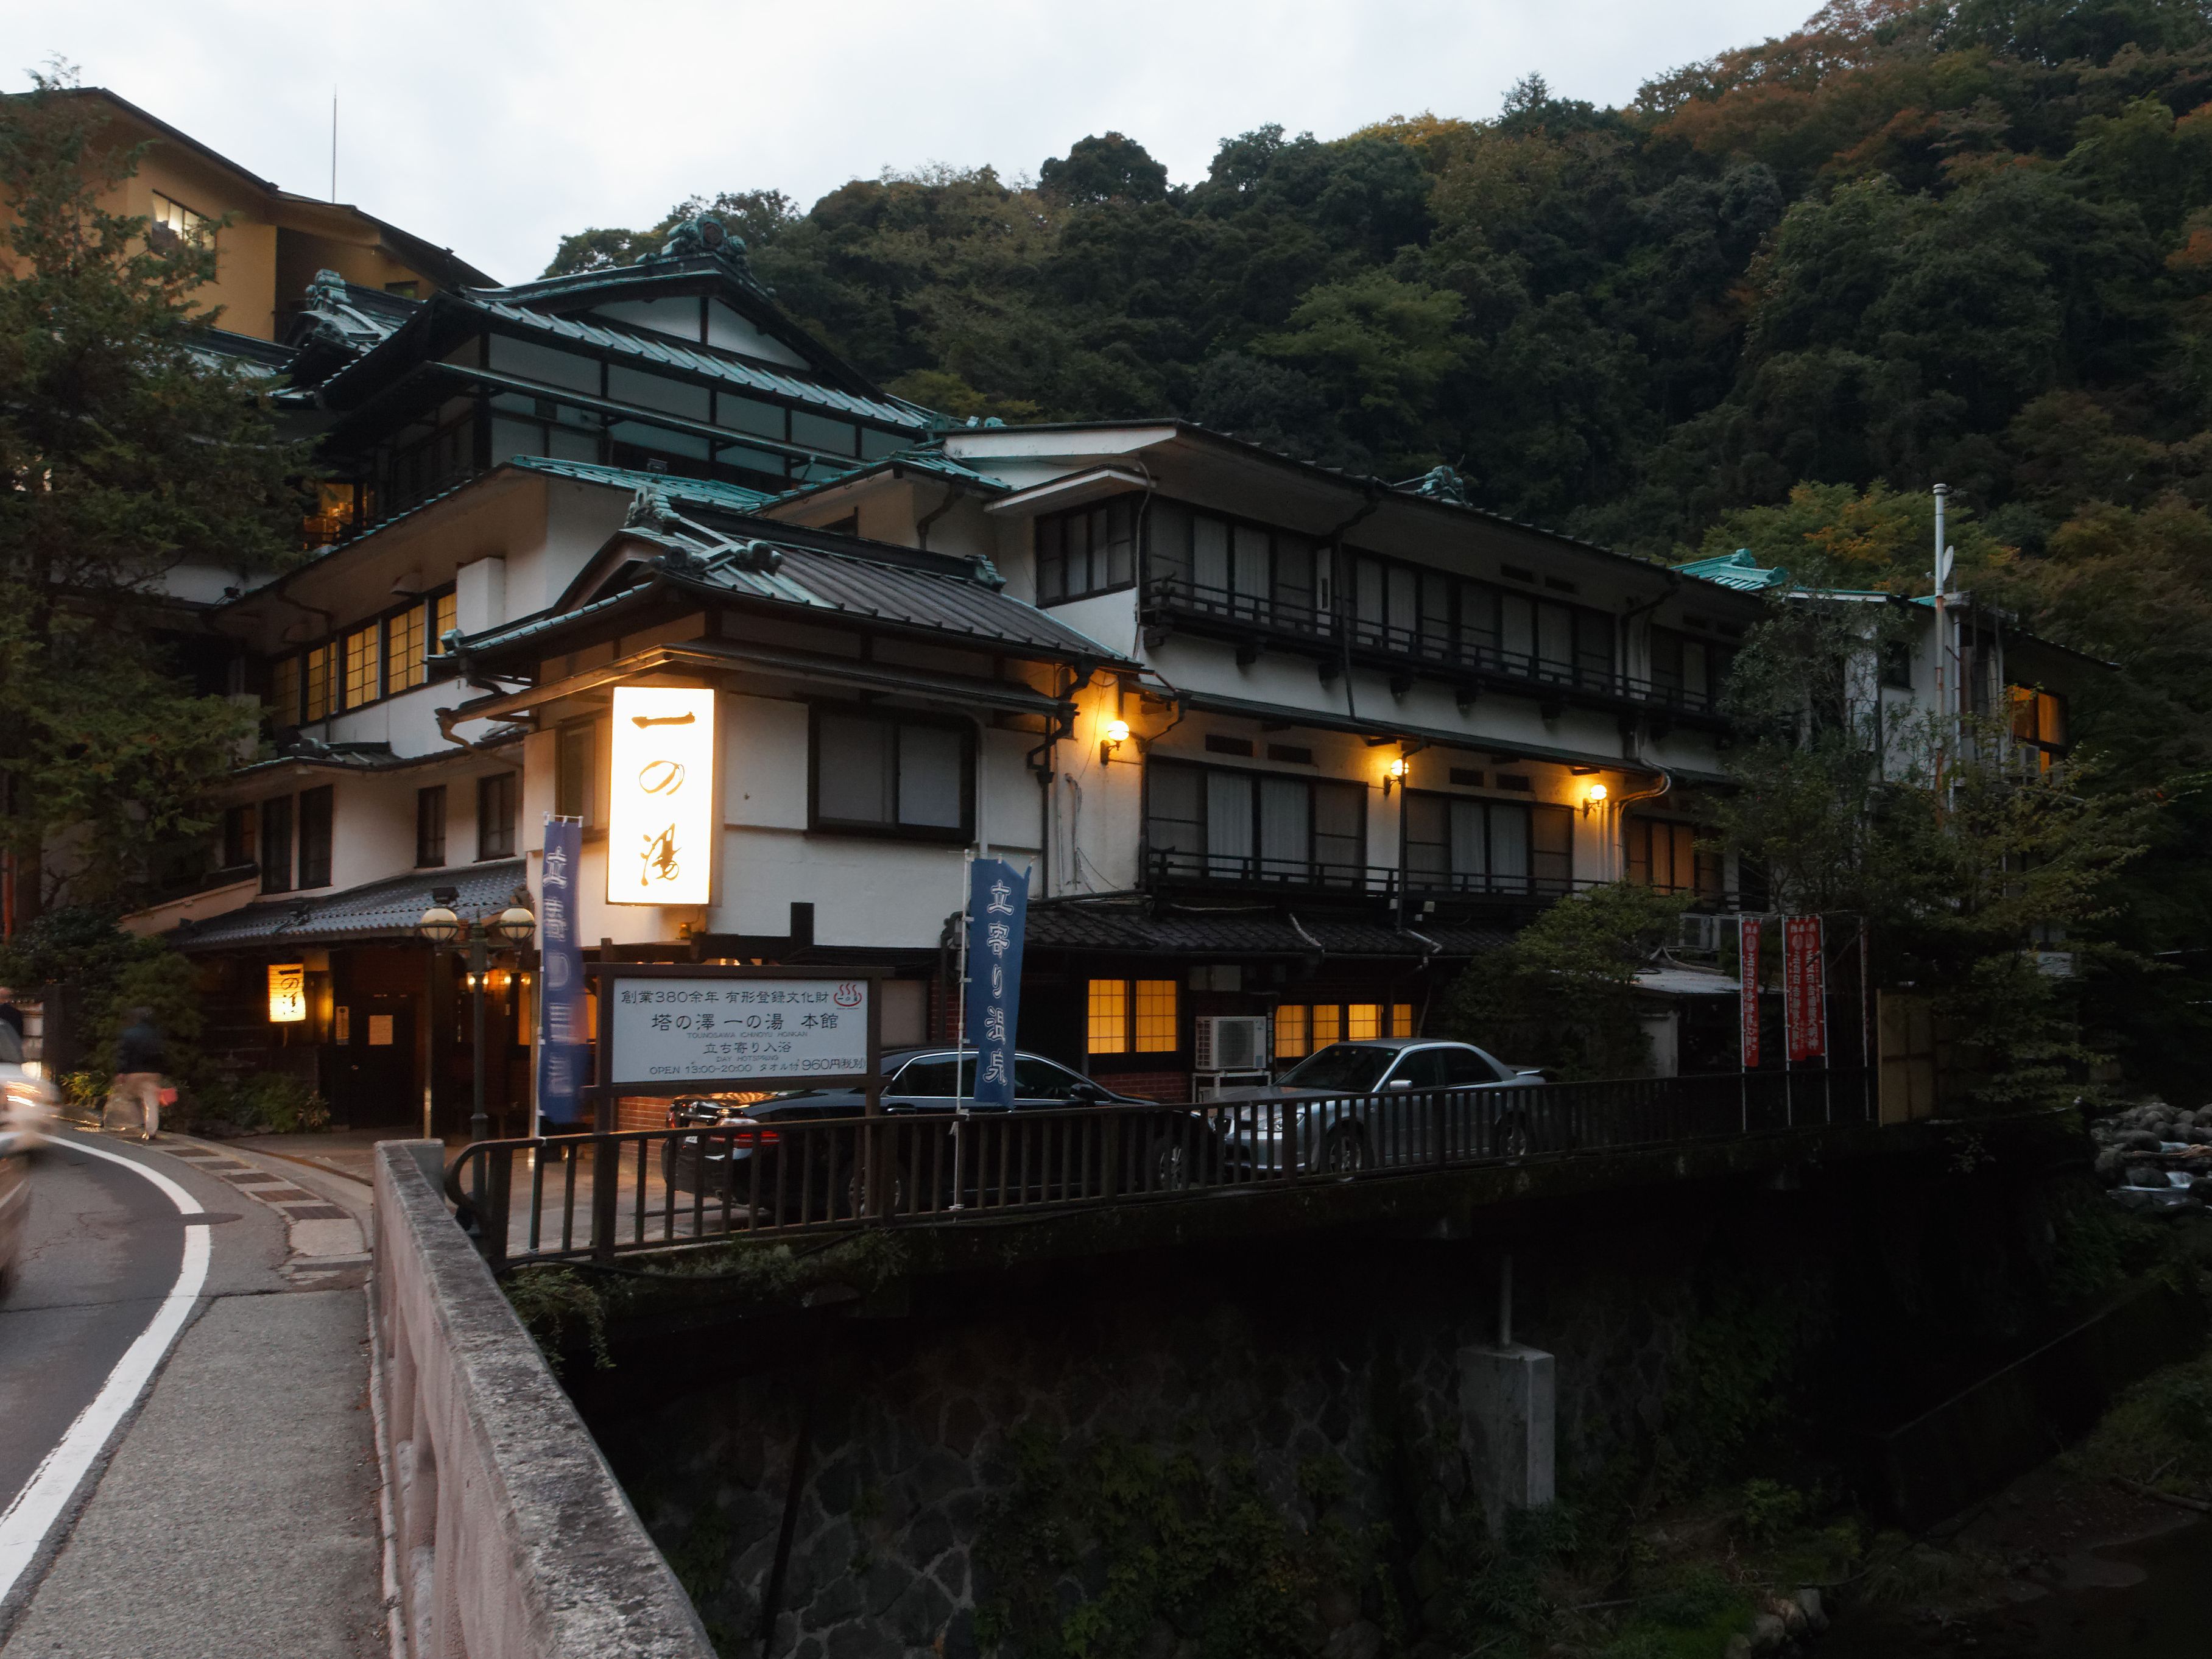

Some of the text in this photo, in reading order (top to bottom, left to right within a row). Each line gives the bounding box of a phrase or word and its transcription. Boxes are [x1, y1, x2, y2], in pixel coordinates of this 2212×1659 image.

[631, 711, 696, 886] 一の湯
[621, 991, 830, 1004] 創業380余年 有形登録文化財
[652, 1013, 839, 1031] 塔の澤 一の湯 本館
[703, 1041, 791, 1054] 立ち寄り入浴
